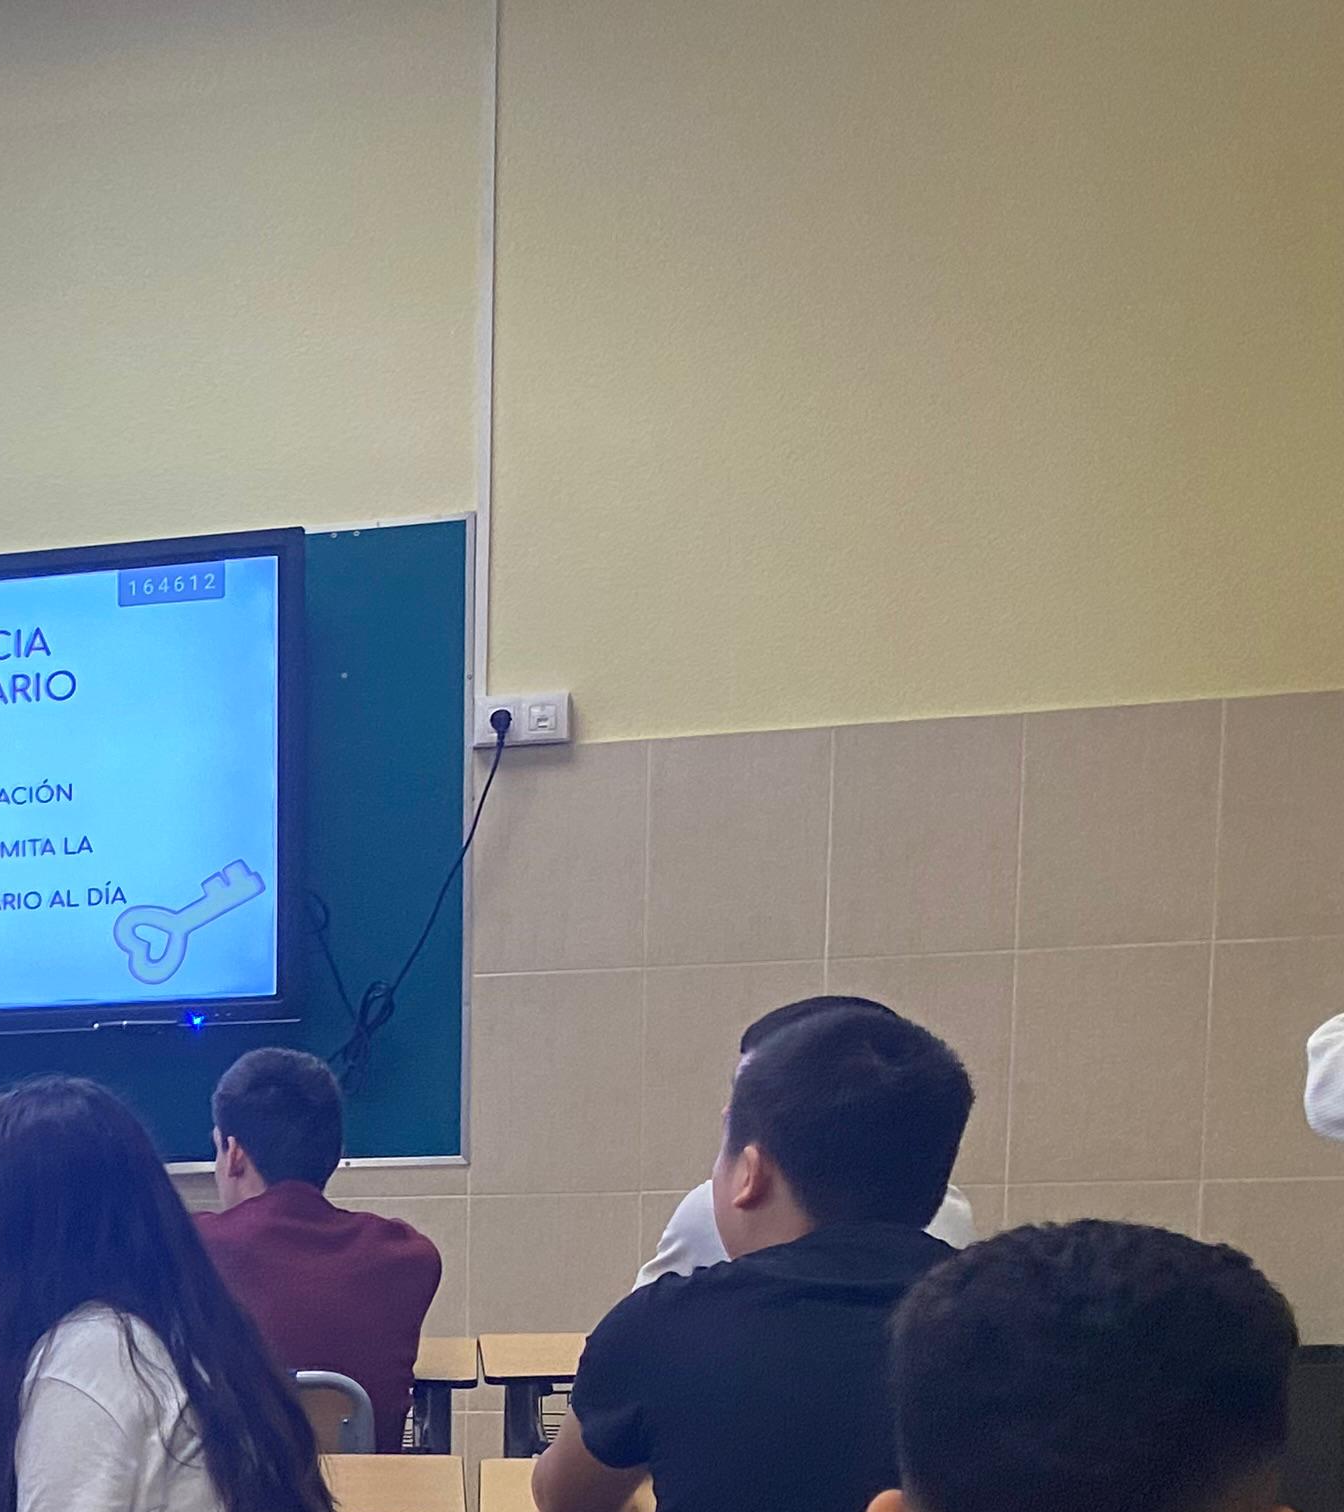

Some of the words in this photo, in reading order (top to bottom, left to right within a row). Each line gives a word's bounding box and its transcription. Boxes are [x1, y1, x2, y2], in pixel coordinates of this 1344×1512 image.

[128, 573, 216, 596] 164612
[63, 835, 94, 856] LA
[48, 889, 80, 909] AL
[87, 880, 128, 907] DÍA
